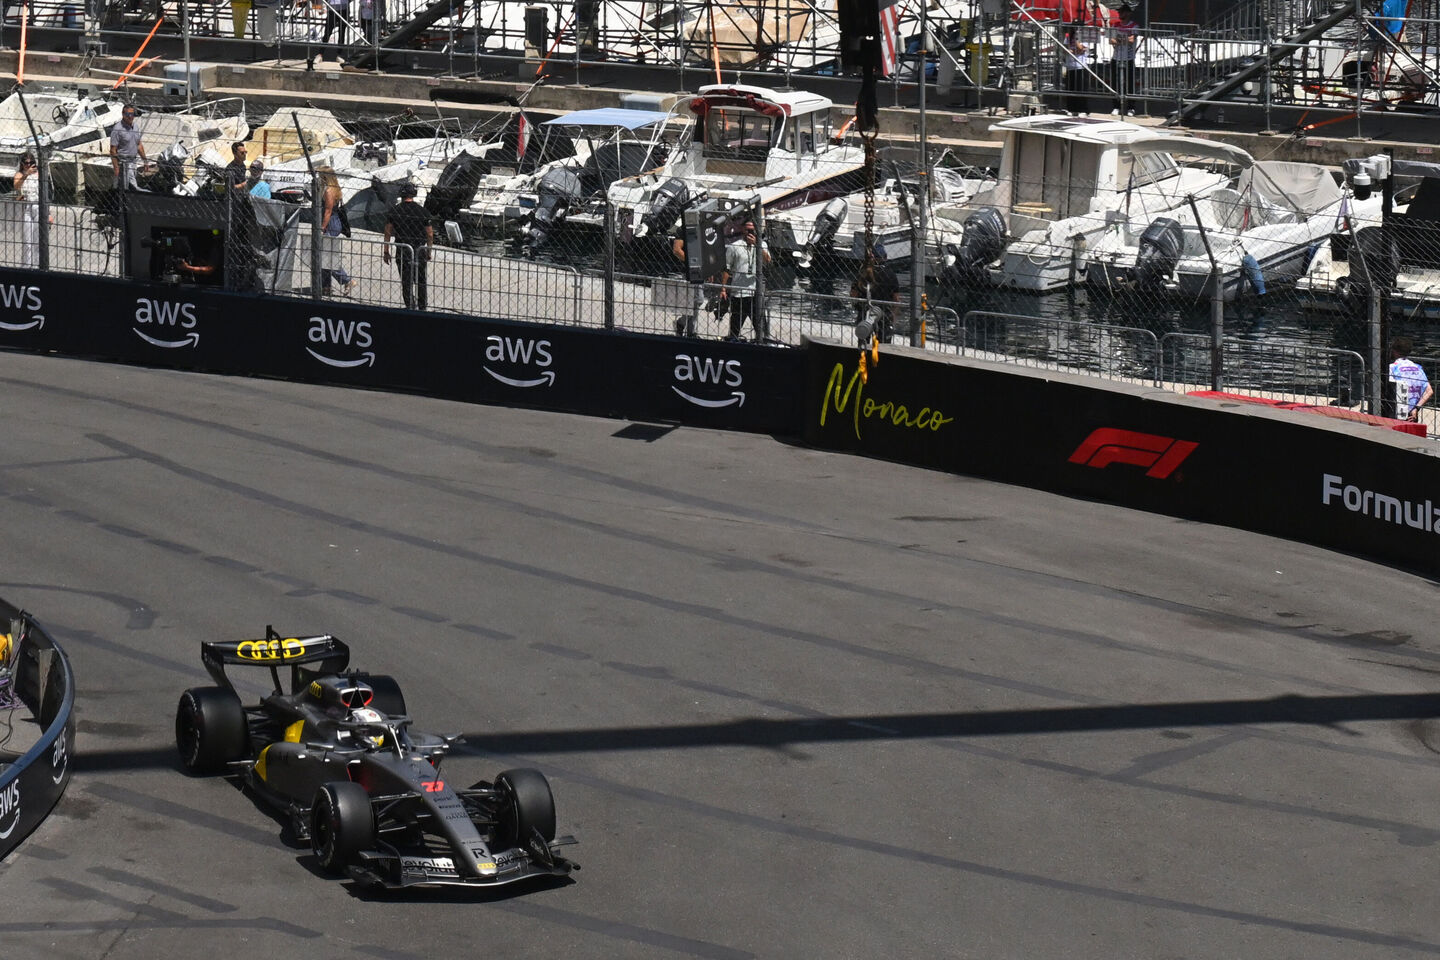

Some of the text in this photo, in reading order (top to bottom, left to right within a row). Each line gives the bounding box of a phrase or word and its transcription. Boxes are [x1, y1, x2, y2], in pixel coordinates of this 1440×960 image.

[135, 298, 197, 328] aws
[308, 316, 372, 348] aws
[485, 335, 552, 367] aws
[674, 354, 743, 387] aws
[820, 362, 954, 441] Monaco
[1067, 427, 1201, 480] F1
[401, 859, 457, 873] evolut
